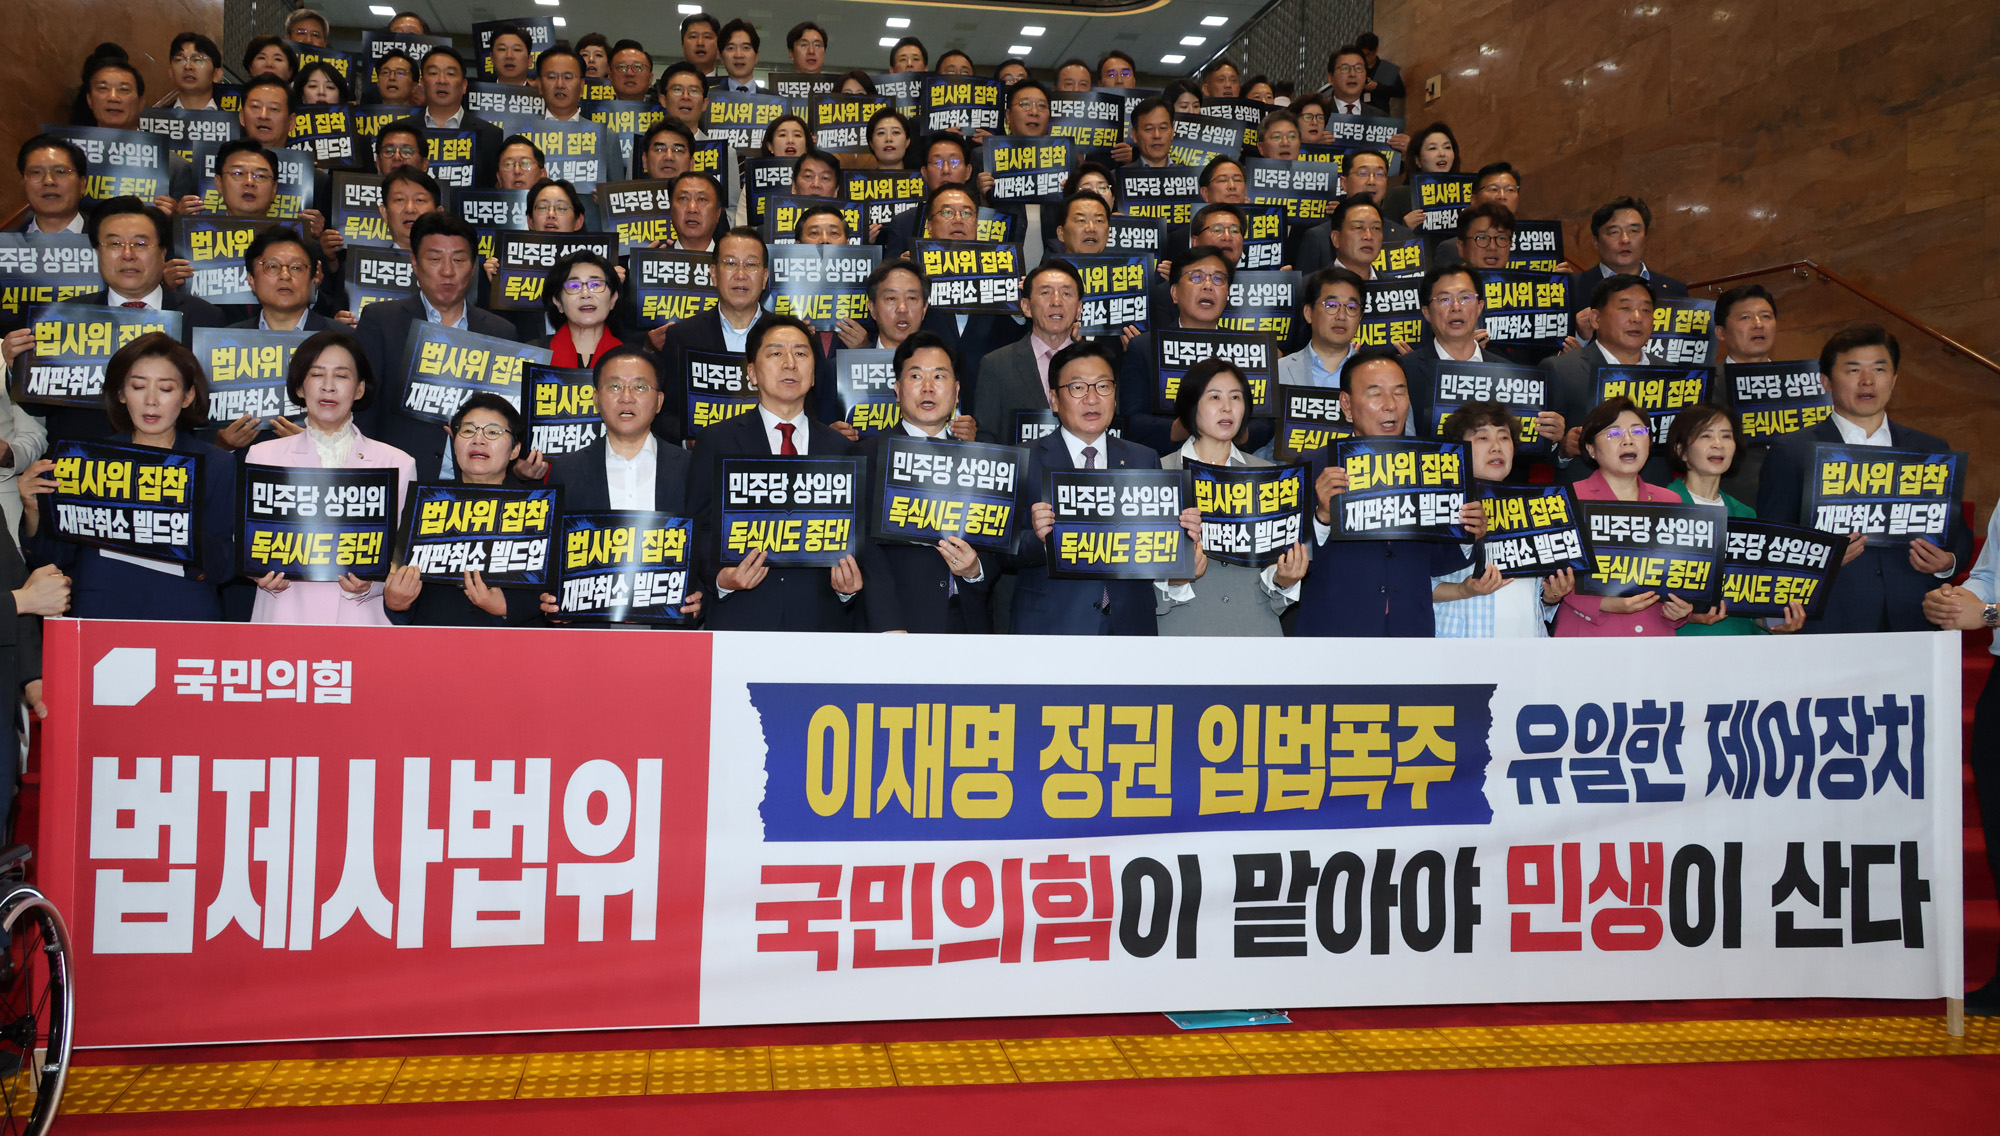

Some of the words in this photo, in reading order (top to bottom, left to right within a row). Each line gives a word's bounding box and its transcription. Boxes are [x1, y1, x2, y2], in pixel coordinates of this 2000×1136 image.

[468, 92, 507, 112] 민주당
[508, 94, 545, 115] 상임위
[930, 84, 972, 106] 법사위
[974, 84, 998, 105] 집착
[315, 112, 345, 133] 집착
[710, 102, 753, 124] 법사위
[818, 102, 859, 124] 법사위
[929, 109, 969, 131] 재판취소
[970, 108, 999, 129] 빌드업
[1050, 100, 1085, 119] 민주당
[1087, 101, 1119, 122] 상임위
[187, 121, 230, 142] 상임위
[567, 131, 597, 155] 집착
[816, 127, 858, 149] 재판취소
[1093, 127, 1118, 147] 중단!
[1201, 125, 1238, 147] 상임위
[1333, 121, 1364, 141] 민주당
[108, 142, 158, 168] 상임위
[315, 136, 352, 160] 빌드업
[443, 138, 472, 160] 집착
[994, 146, 1036, 172] 법사위
[1040, 145, 1066, 168] 집착
[563, 160, 598, 183] 빌드업
[755, 166, 793, 188] 민주당
[1254, 168, 1290, 189] 민주당
[1293, 171, 1329, 192] 상임위
[849, 179, 893, 201] 법사위
[897, 177, 924, 198] 집착
[993, 176, 1036, 199] 재판취소
[1125, 177, 1162, 197] 민주당
[1163, 176, 1199, 196] 상임위
[1421, 182, 1461, 206] 법사위
[463, 200, 507, 224] 민주당
[609, 191, 653, 214] 민주당
[1299, 199, 1327, 219] 중단!
[616, 220, 668, 244] 독식시도
[976, 219, 1006, 243] 집착
[1118, 228, 1159, 249] 상임위
[1252, 215, 1280, 238] 집착
[507, 242, 557, 267] 민주당
[1519, 230, 1556, 252] 상임위
[923, 250, 977, 276] 법사위
[980, 250, 1014, 274] 집착
[1247, 243, 1281, 267] 빌드업
[1389, 244, 1421, 271] 집착
[360, 258, 411, 287] 민주당
[642, 259, 690, 284] 민주당
[773, 258, 822, 284] 민주당
[825, 257, 872, 286] 상임위
[1112, 264, 1144, 293] 집착
[979, 278, 1018, 303] 빌드업
[1246, 283, 1292, 307] 상임위
[1373, 288, 1420, 313] 상임위
[1485, 281, 1534, 308] 법사위
[1536, 281, 1565, 307] 집착
[642, 295, 703, 320] 독식시도
[774, 293, 833, 321] 독식시도
[1108, 295, 1147, 324] 빌드업
[1534, 312, 1569, 340] 빌드업
[1676, 308, 1711, 334] 집착
[35, 320, 112, 357] 법사위
[1666, 339, 1708, 365] 빌드업
[211, 345, 283, 382] 법사위
[419, 341, 491, 381] 법사위
[27, 366, 105, 397] 재판취소
[691, 361, 742, 392] 민주당
[1440, 373, 1492, 402] 민주당
[1495, 377, 1544, 406] 상임위
[1736, 373, 1782, 400] 민주당
[208, 387, 280, 422] 재판취소
[1667, 378, 1702, 409] 집착
[1290, 396, 1340, 422] 민주당
[1742, 408, 1800, 438] 독식시도
[53, 456, 132, 499] 법사위
[137, 465, 188, 503] 집착
[892, 450, 953, 486] 민주당
[956, 457, 1015, 493] 상임위
[1346, 451, 1416, 492] 법사위
[1420, 452, 1460, 485] 집착
[1822, 462, 1895, 496] 법사위
[1898, 463, 1949, 496] 집착
[252, 481, 320, 517] 민주당
[324, 485, 385, 518] 상임위
[729, 472, 788, 505] 민주당
[792, 472, 852, 505] 상임위
[1057, 485, 1115, 517] 민주당
[1120, 486, 1179, 517] 상임위
[1194, 479, 1253, 515] 법사위
[1258, 476, 1299, 513] 집착
[57, 503, 130, 541] 재판취소
[133, 510, 189, 546] 빌드업
[419, 499, 497, 536] 법사위
[501, 499, 549, 533] 집착
[888, 494, 963, 533] 독식시도
[965, 500, 1011, 537] 중단!
[1345, 495, 1416, 532] 재판취소
[1419, 493, 1464, 527] 빌드업
[1481, 497, 1526, 533] 법사위
[1528, 494, 1567, 529] 집착
[1813, 503, 1886, 535] 재판취소
[1888, 503, 1948, 535] 빌드업
[728, 518, 802, 554] 독식시도
[804, 518, 850, 553] 중단!
[1199, 520, 1252, 554] 재판취소
[1254, 513, 1302, 554] 빌드업
[1590, 514, 1651, 544] 민주당
[1654, 518, 1714, 549] 상임위
[251, 530, 332, 566] 독식시도
[335, 531, 384, 566] 중단!
[408, 540, 487, 575] 재판취소
[488, 538, 548, 574] 빌드업
[566, 528, 636, 570] 법사위
[641, 527, 687, 563] 집착
[1060, 531, 1132, 565] 독식시도
[1133, 530, 1180, 562] 중단!
[1534, 528, 1583, 563] 빌드업
[1768, 535, 1831, 569] 상임위
[1666, 558, 1712, 591] 중단!
[560, 576, 630, 613] 재판취소
[632, 570, 687, 609] 빌드업
[1774, 575, 1819, 606] 중단!
[173, 658, 352, 705] 국민의힘
[806, 703, 1016, 819] 이재명
[1040, 704, 1173, 820] 정권
[1198, 704, 1456, 816] 입법폭주
[1506, 699, 1686, 805] 유일한
[1704, 694, 1925, 801] 제어장치
[89, 755, 663, 954] 법제사법위
[755, 854, 1202, 972] 국민의힘이
[1232, 849, 1481, 958] 맡아야
[1506, 841, 1743, 952] 민생이
[1771, 841, 1931, 950] 산다
